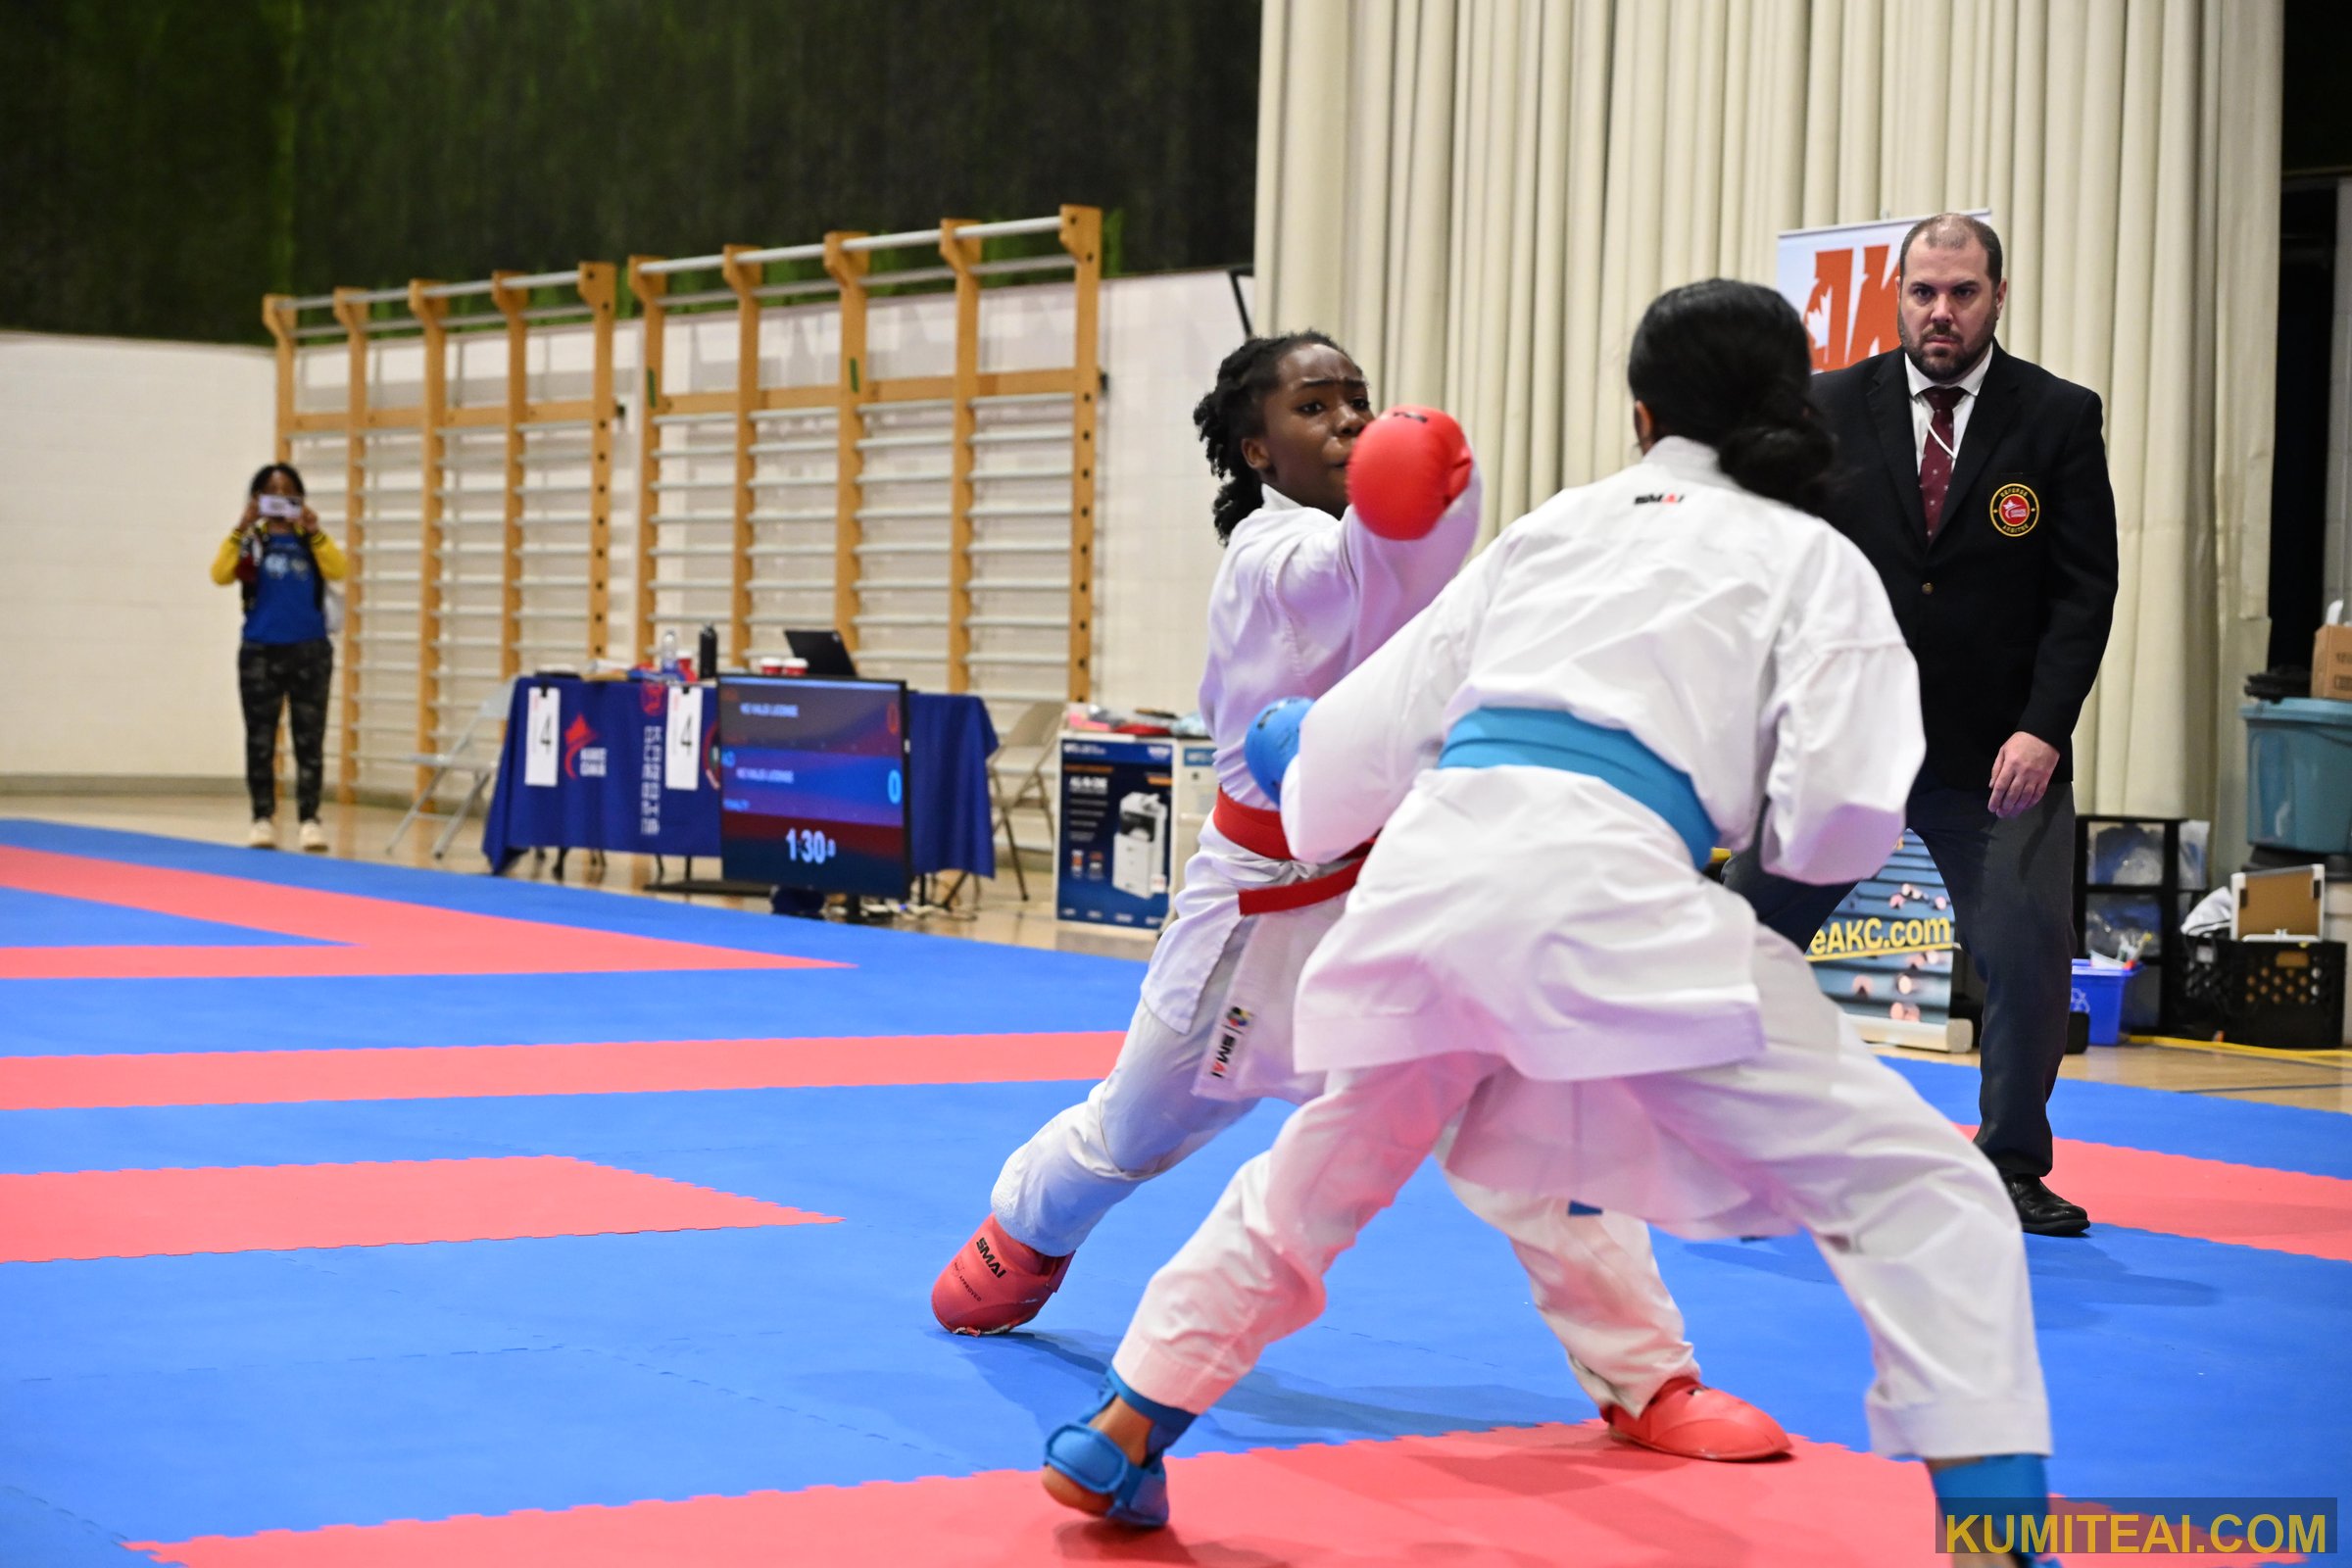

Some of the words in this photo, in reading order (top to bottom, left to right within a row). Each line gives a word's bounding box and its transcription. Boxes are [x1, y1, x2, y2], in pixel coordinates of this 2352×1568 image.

[888, 769, 903, 805] 0
[1210, 1032, 1237, 1079] SMAI
[976, 1237, 1007, 1279] SMAI
